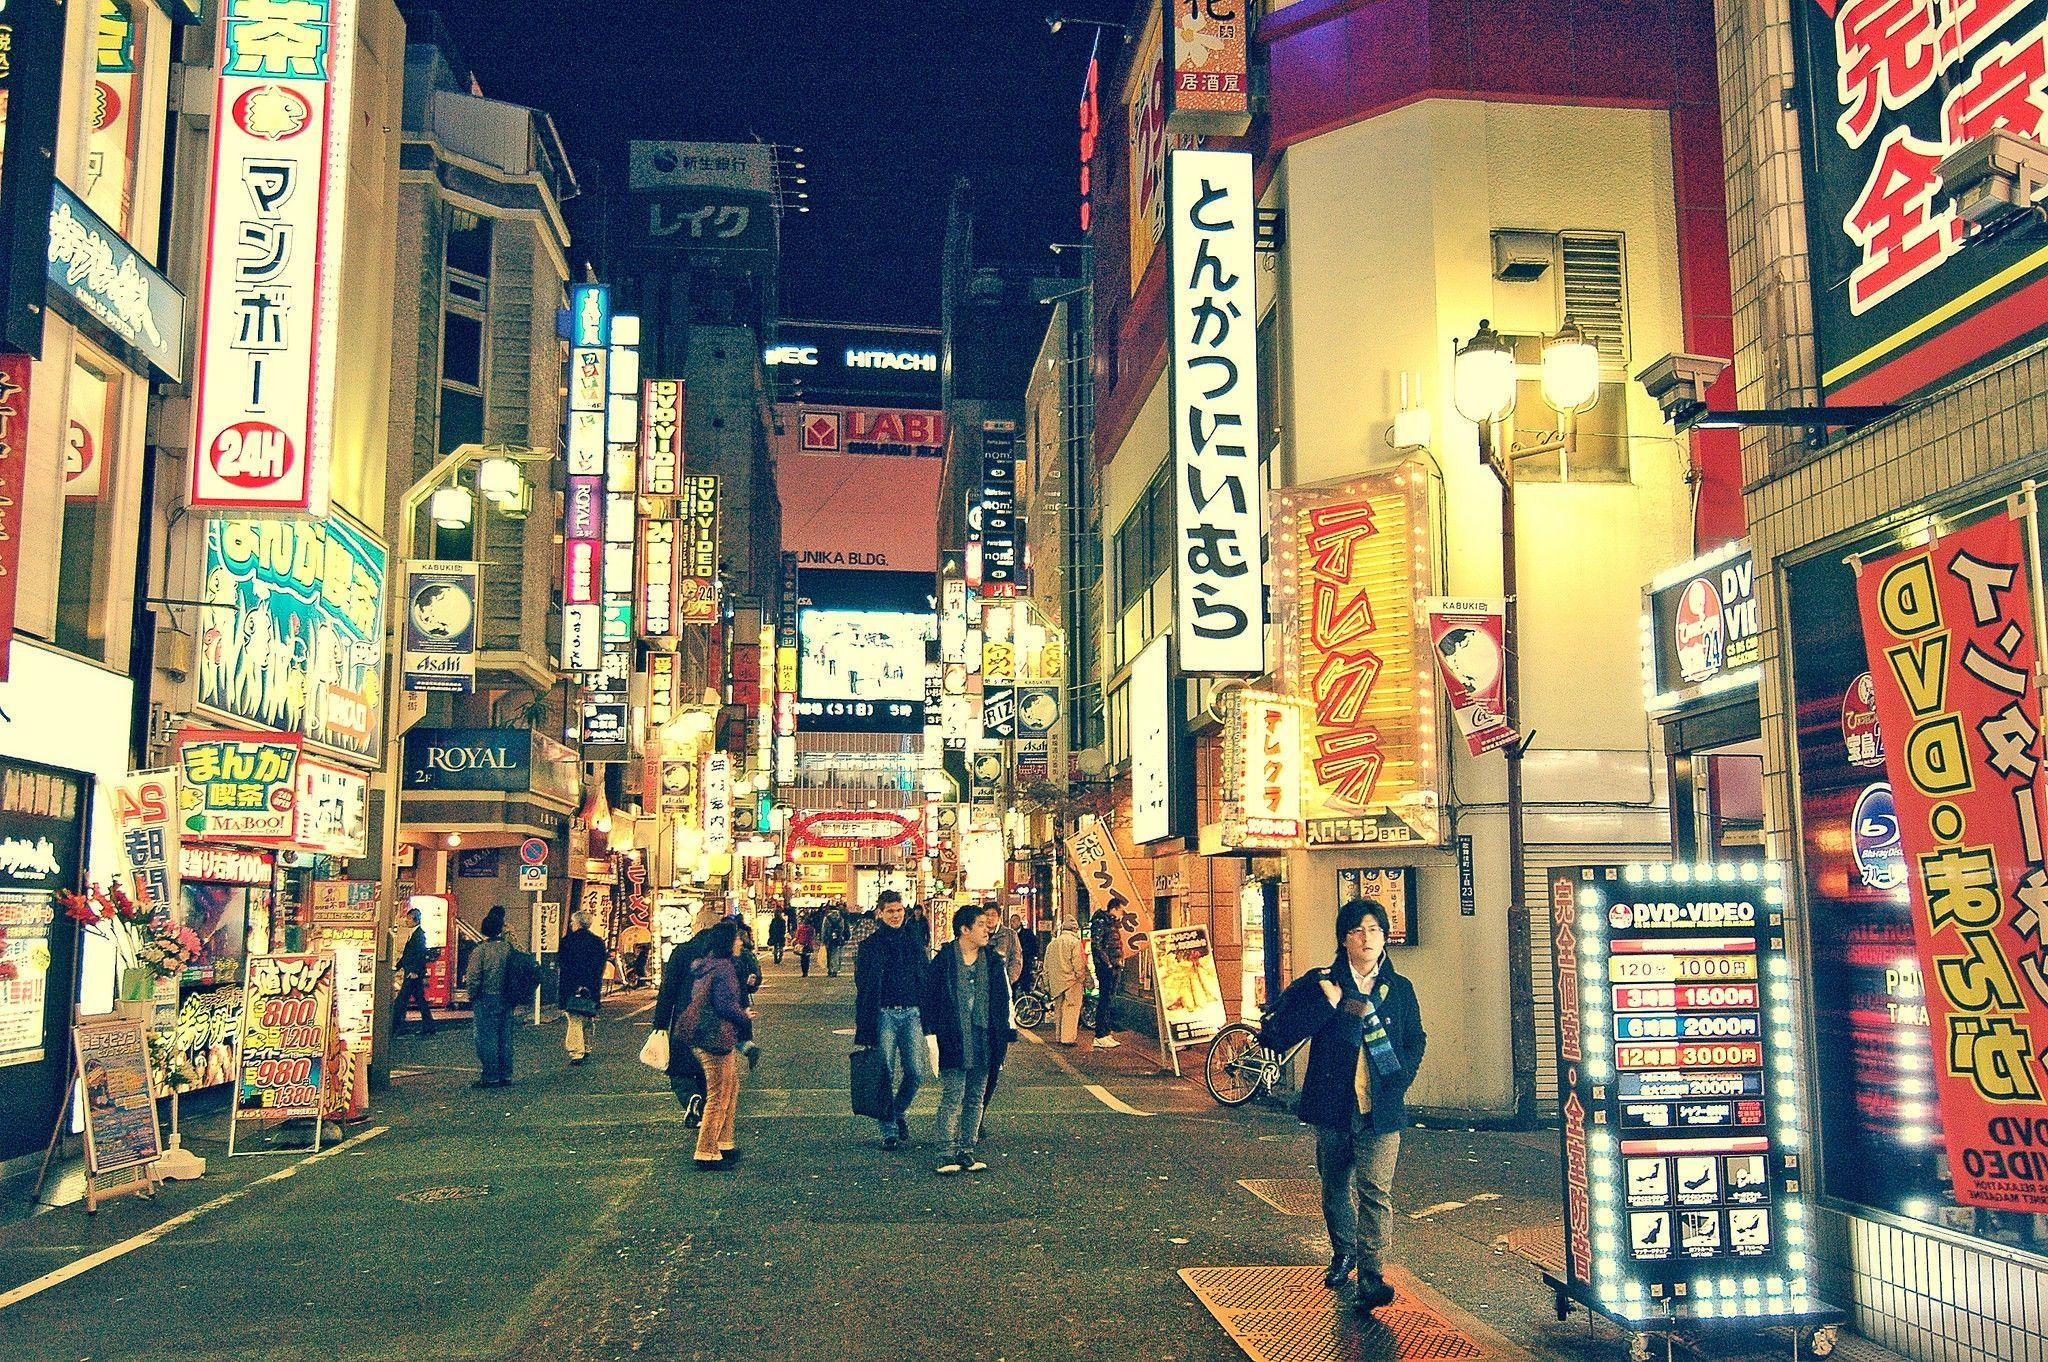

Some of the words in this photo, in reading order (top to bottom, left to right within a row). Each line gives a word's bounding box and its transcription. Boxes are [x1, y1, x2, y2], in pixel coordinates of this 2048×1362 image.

[1180, 73, 1240, 93] 居酒屋
[650, 203, 750, 237] レイク
[230, 156, 298, 414] マンボー
[847, 350, 937, 371] HITACHI
[1187, 178, 1249, 640] とんかつにいむら
[848, 412, 943, 446] LABI
[216, 429, 285, 478] 24H
[575, 484, 591, 530] ROYAL
[848, 552, 889, 566] BLDG.
[417, 656, 460, 673] Asahi
[1307, 501, 1386, 814] テレクラ
[187, 745, 292, 783] まんが
[426, 747, 516, 772] ROYAL
[1263, 709, 1283, 813] テレクラ
[415, 770, 431, 783] 2F
[211, 783, 264, 807] 喫茶
[627, 865, 648, 927] ラーメン
[1461, 886, 1473, 897] 23
[253, 959, 333, 996] 値下げ
[1680, 960, 1746, 976] 1000円
[1685, 987, 1754, 1006] 1500円
[1684, 1017, 1756, 1036] 2000円
[1683, 1046, 1757, 1065] 3000円
